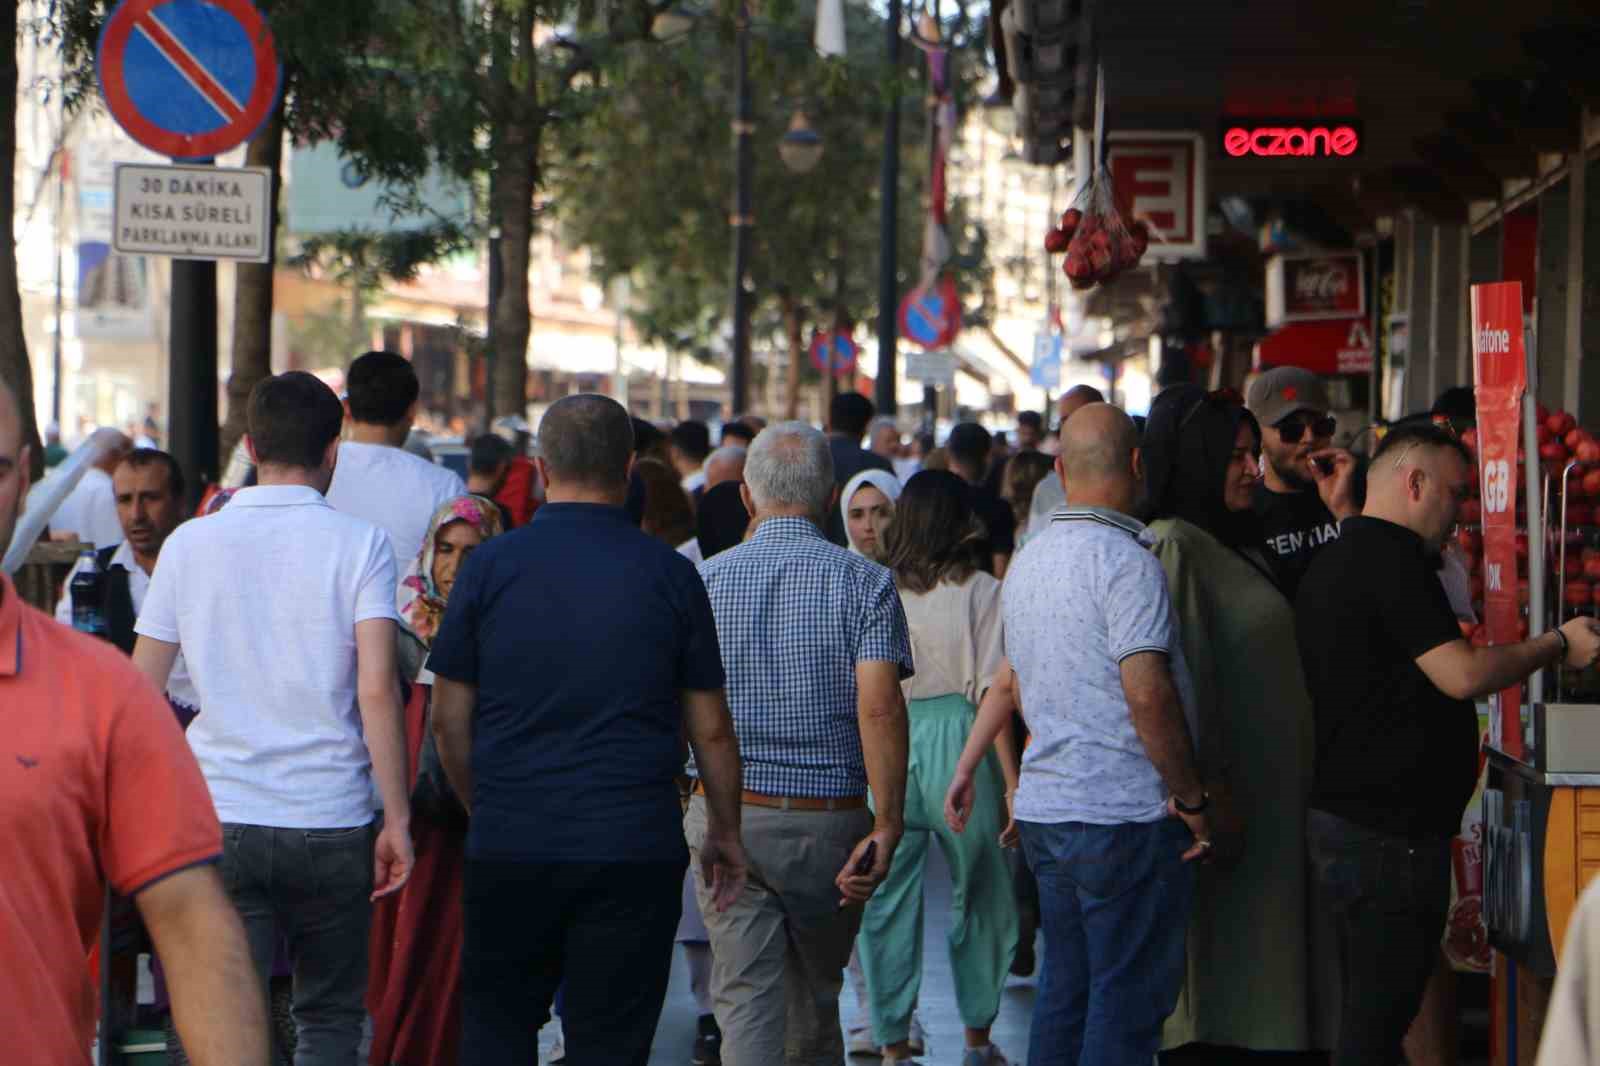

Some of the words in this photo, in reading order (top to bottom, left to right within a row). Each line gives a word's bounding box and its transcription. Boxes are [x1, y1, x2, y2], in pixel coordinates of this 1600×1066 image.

[1224, 127, 1358, 158] eczane
[140, 177, 162, 193] 30
[168, 177, 242, 197] DAKİKA
[1114, 156, 1175, 231] E
[131, 202, 176, 221] KISA
[182, 202, 252, 224] SÜRELİ
[1485, 460, 1508, 512] GB
